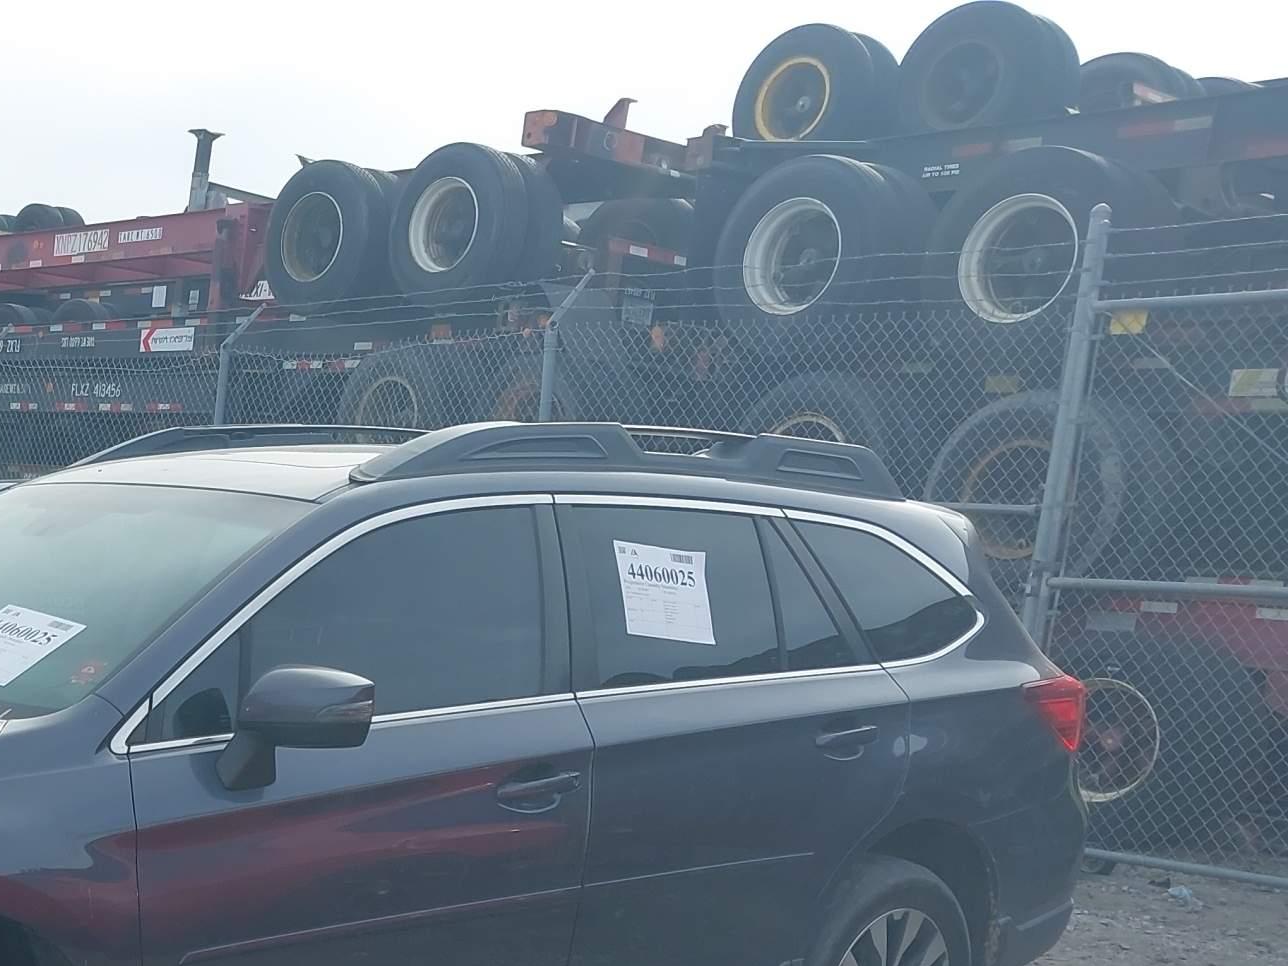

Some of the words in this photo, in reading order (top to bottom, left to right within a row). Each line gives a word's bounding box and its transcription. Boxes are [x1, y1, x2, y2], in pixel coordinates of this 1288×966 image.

[71, 382, 90, 397] FLXZ
[93, 382, 121, 398] 413456
[627, 562, 696, 588] 44060025
